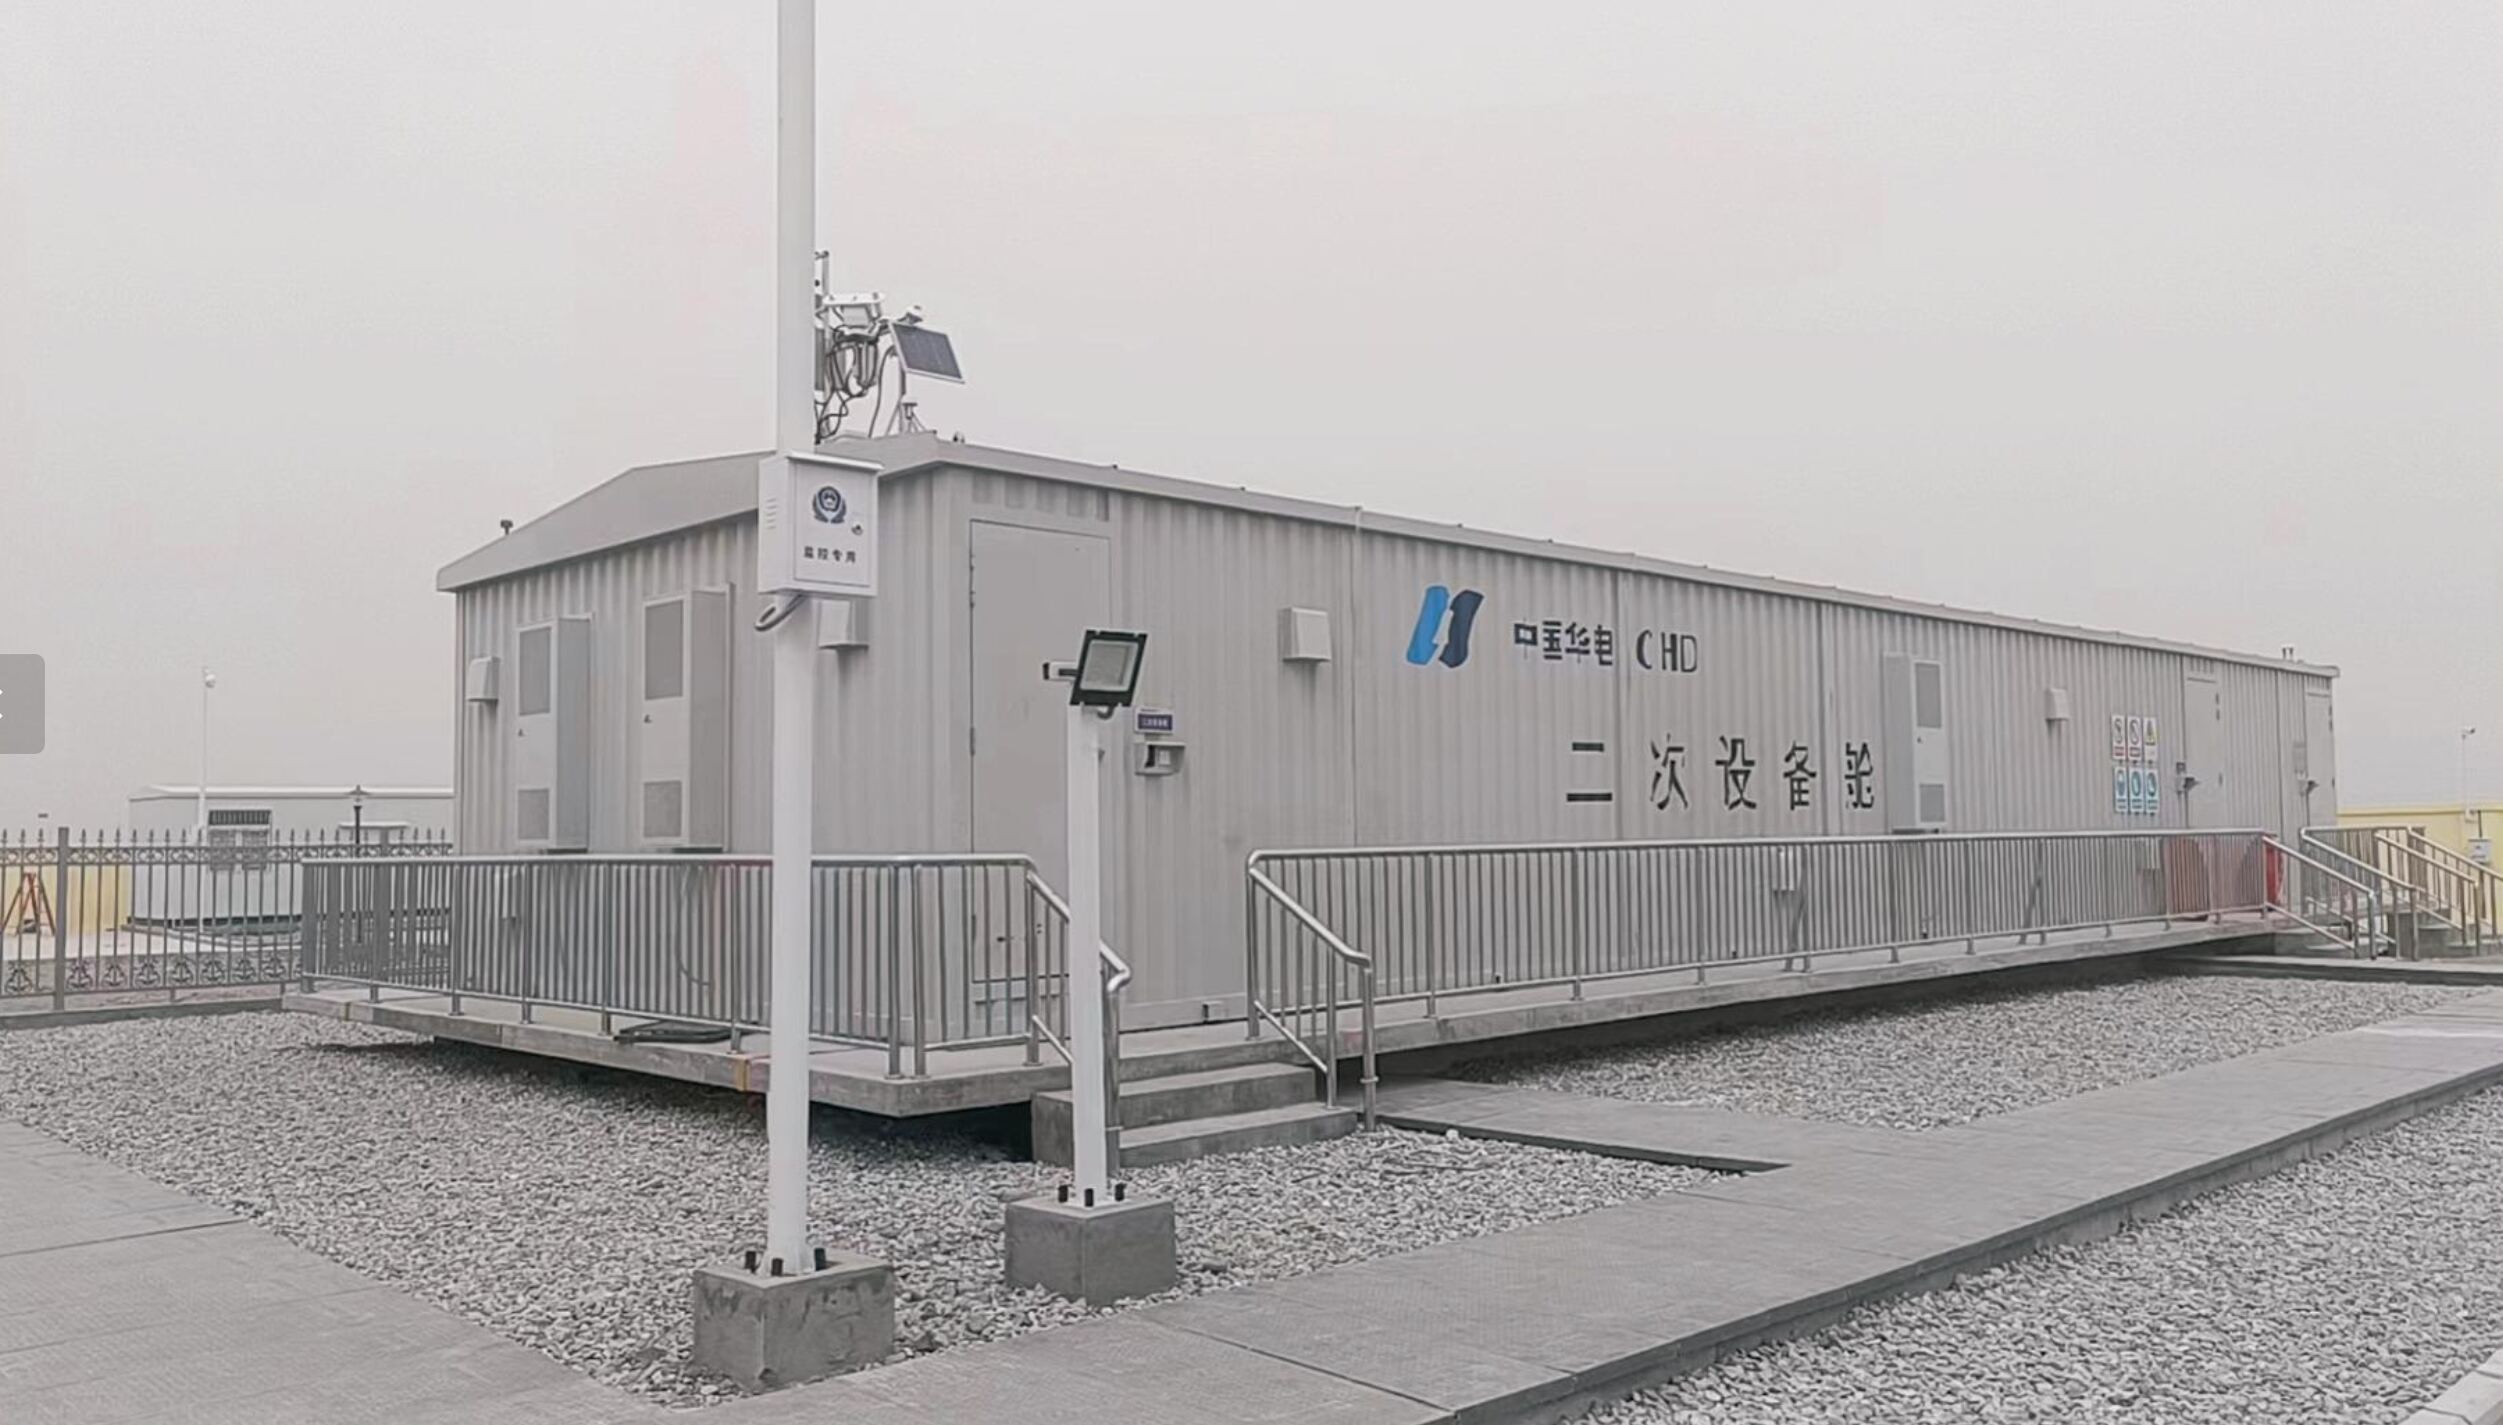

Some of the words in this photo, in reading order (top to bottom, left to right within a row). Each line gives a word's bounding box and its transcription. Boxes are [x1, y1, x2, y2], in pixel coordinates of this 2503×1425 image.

[1513, 618, 1613, 666] 中国华电
[1635, 629, 1698, 673] CHD
[1566, 732, 1875, 811] 二次设备舱
